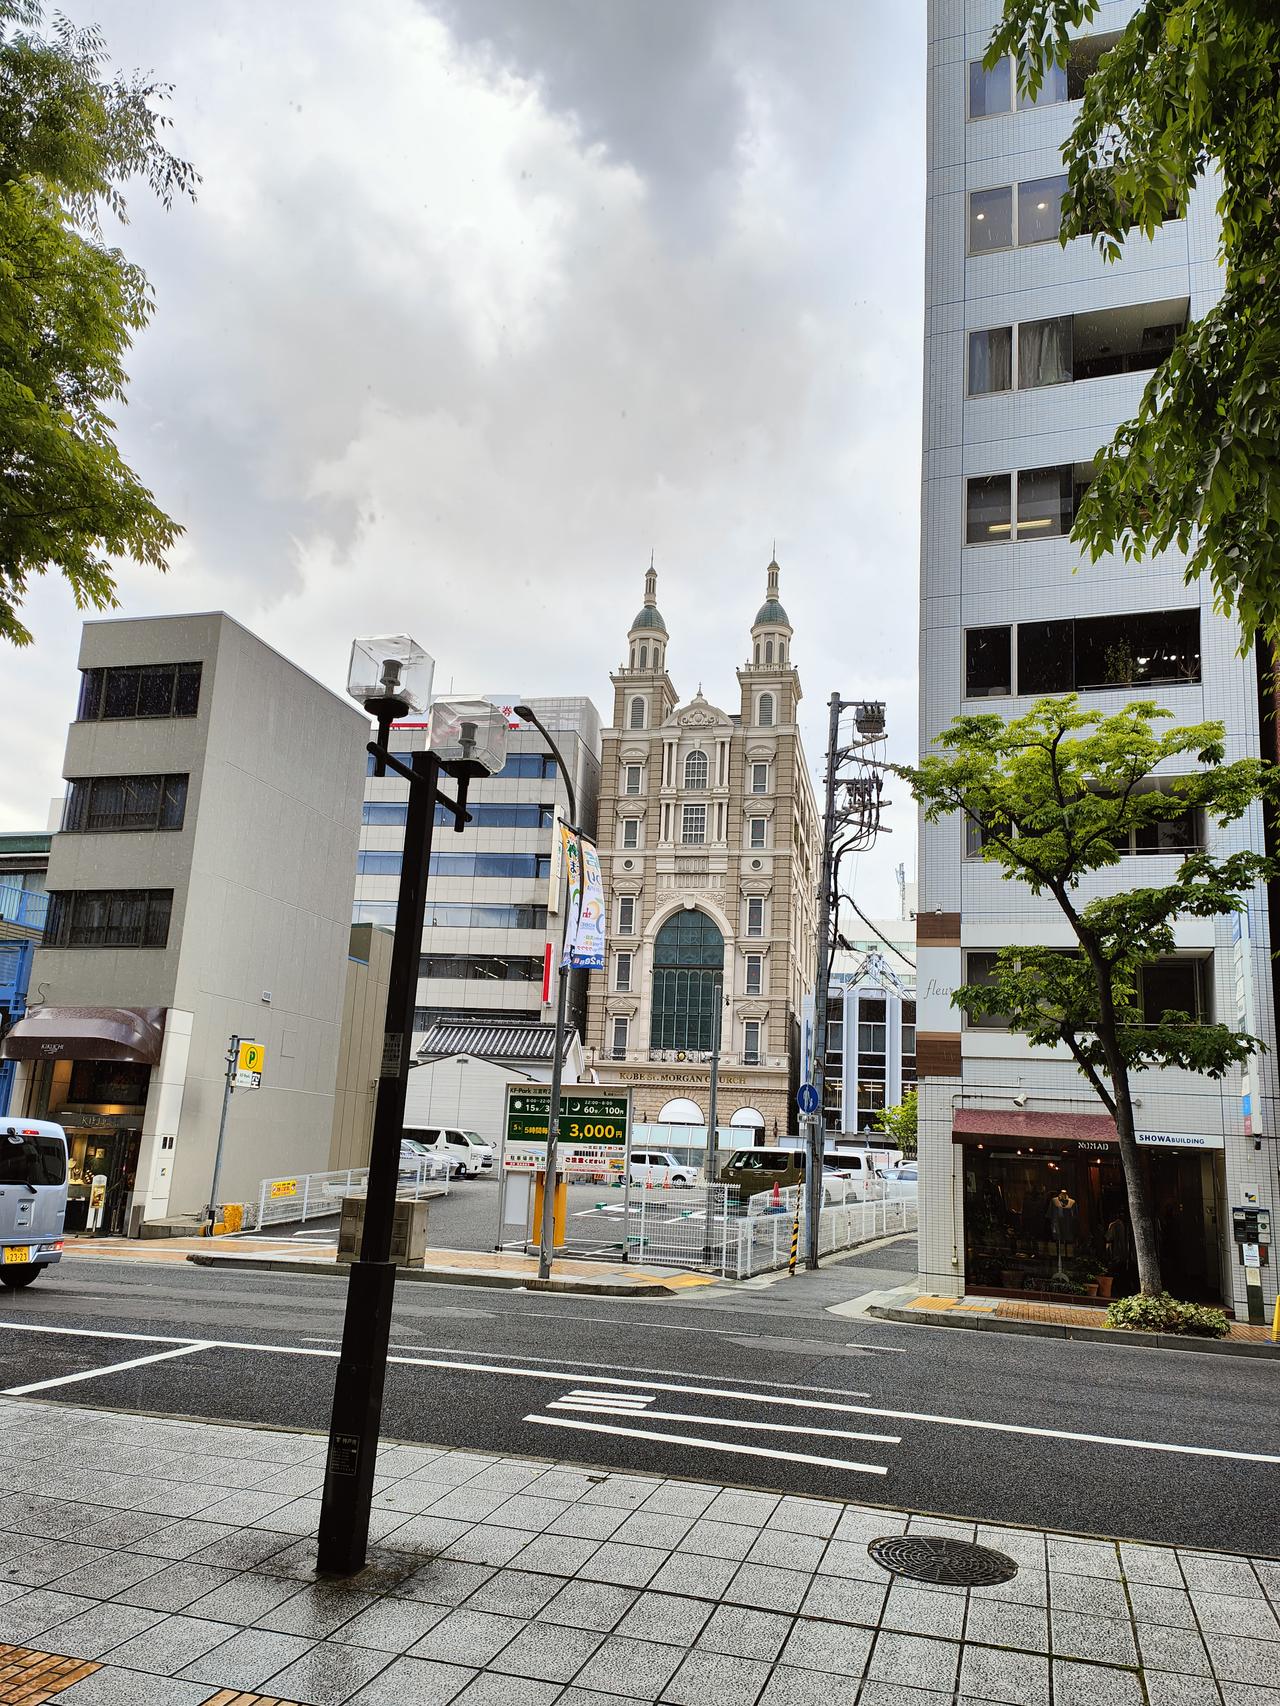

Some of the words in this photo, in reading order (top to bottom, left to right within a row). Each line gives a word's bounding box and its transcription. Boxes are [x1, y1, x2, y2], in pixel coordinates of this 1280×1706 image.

[41, 1043, 64, 1051] KIKUCHI
[619, 1072, 643, 1081] KOBE
[660, 1074, 702, 1083] MORGAN
[704, 1076, 746, 1084] CURCH
[1139, 1134, 1171, 1143] SHOWA
[1078, 1142, 1109, 1151] NOMAD
